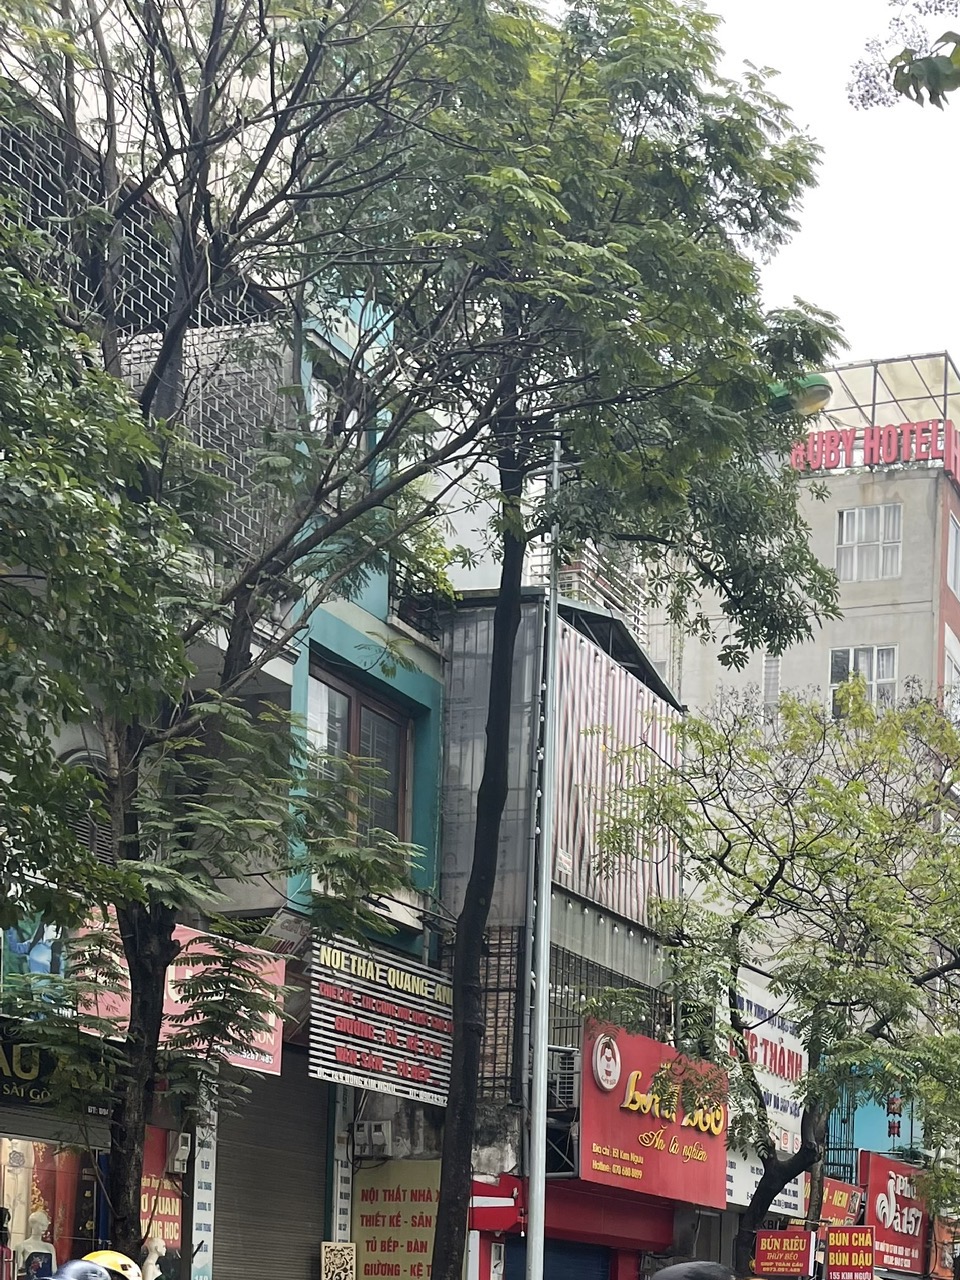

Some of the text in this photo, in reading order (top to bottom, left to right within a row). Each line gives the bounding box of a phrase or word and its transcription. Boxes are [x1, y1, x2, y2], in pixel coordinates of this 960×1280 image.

[864, 419, 944, 465] HOTEL
[387, 966, 429, 997] QUANG
[3, 1082, 52, 1100] SÀI GÒ
[668, 1135, 680, 1155] là
[620, 1150, 629, 1161] Kim
[361, 1186, 433, 1203] NỘI THẤT NHÀ
[832, 1189, 849, 1208] NEM
[151, 1196, 179, 1217] QUAN
[360, 1210, 432, 1228] THIẾT KẾ SẢN
[164, 1221, 179, 1245] HỌC
[829, 1227, 872, 1246] BÚN CHẢ
[366, 1238, 428, 1253] TỦ BẾP BÀN
[760, 1235, 806, 1251] BÚN RIÊU
[829, 1249, 850, 1266] BÚN
[364, 1262, 400, 1277] GIƯỜNG
[410, 1263, 423, 1279] KỆ
[829, 1271, 872, 1280] 155 KIM NGƯU
